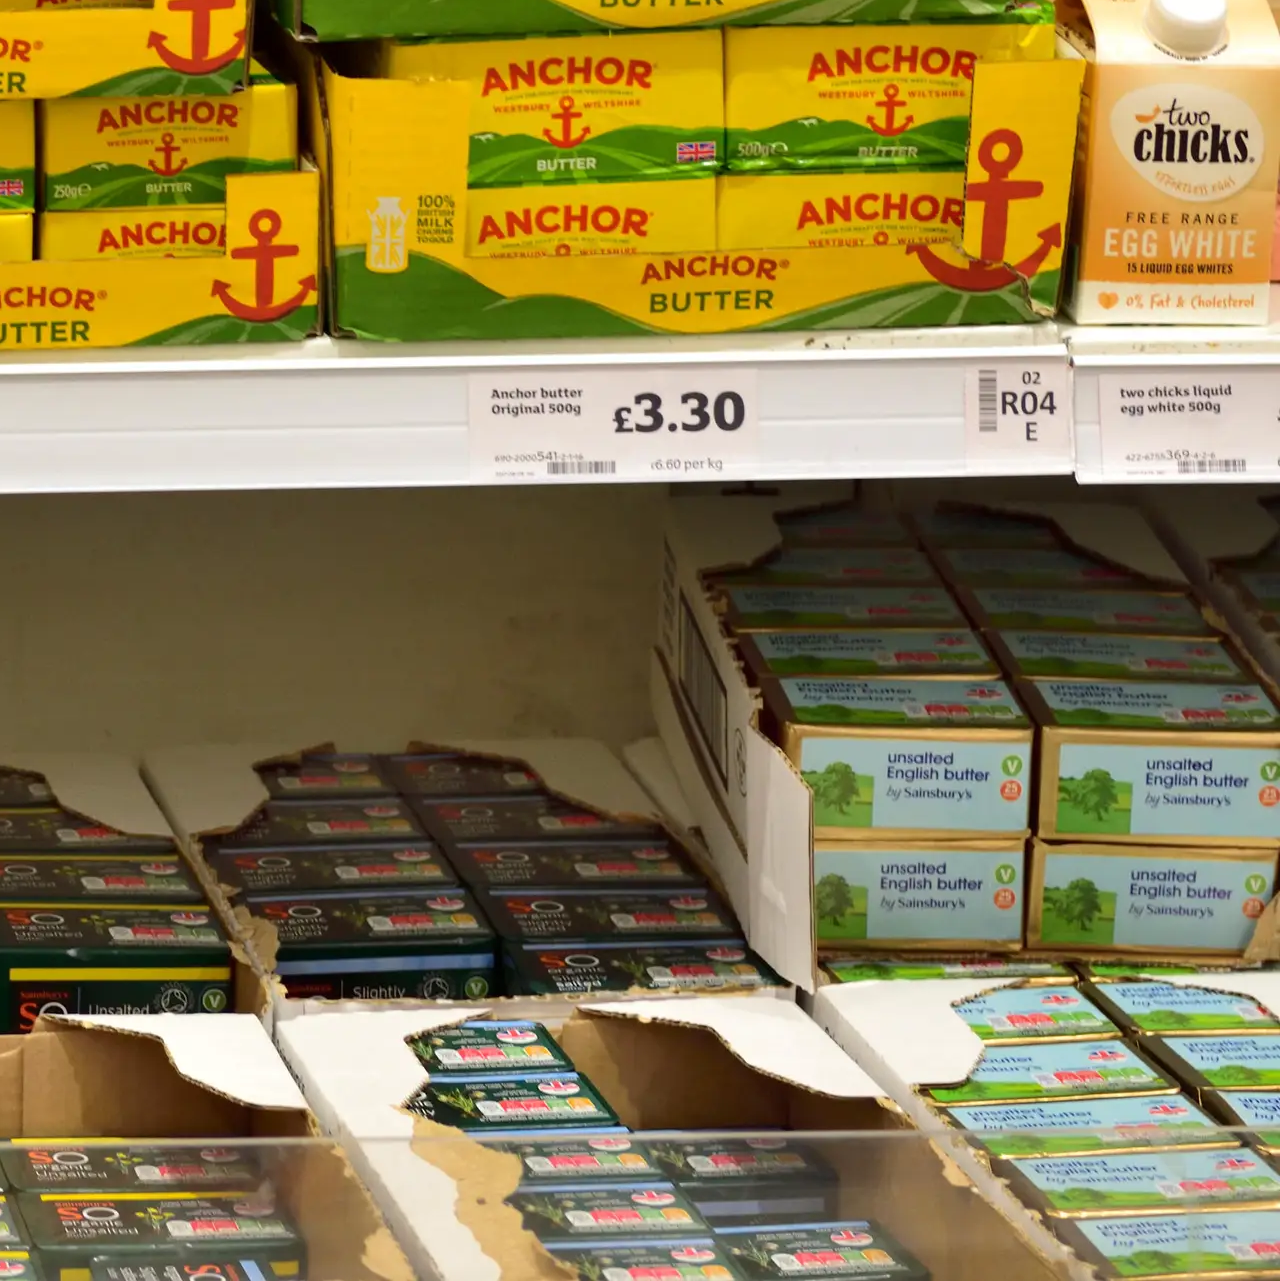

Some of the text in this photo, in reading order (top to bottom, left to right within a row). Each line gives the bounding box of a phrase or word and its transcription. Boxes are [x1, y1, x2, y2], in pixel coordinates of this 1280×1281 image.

[1162, 99, 1210, 126] two
[1126, 212, 1238, 224] FREE RANGE
[1104, 228, 1255, 259] EGG WHITE
[1127, 263, 1233, 275] 15 LIQUID EGG WHITES
[649, 289, 773, 313] BUTTER
[1126, 293, 1254, 309] 0% Fat & Cholesterol
[1022, 372, 1041, 385] 02
[491, 388, 583, 399] Anchor butter
[1121, 385, 1232, 398] two chicks liquid
[491, 403, 581, 416] Original 500g
[1001, 391, 1056, 415] R04
[1121, 402, 1220, 416] egg white 500g
[613, 391, 745, 433] £3.30
[1026, 423, 1037, 441] E
[888, 753, 954, 765] unsalted
[1146, 759, 1213, 771] unsalted
[887, 766, 990, 782] English butter
[1145, 773, 1249, 788] English butter
[887, 786, 972, 800] by Sainsbury's
